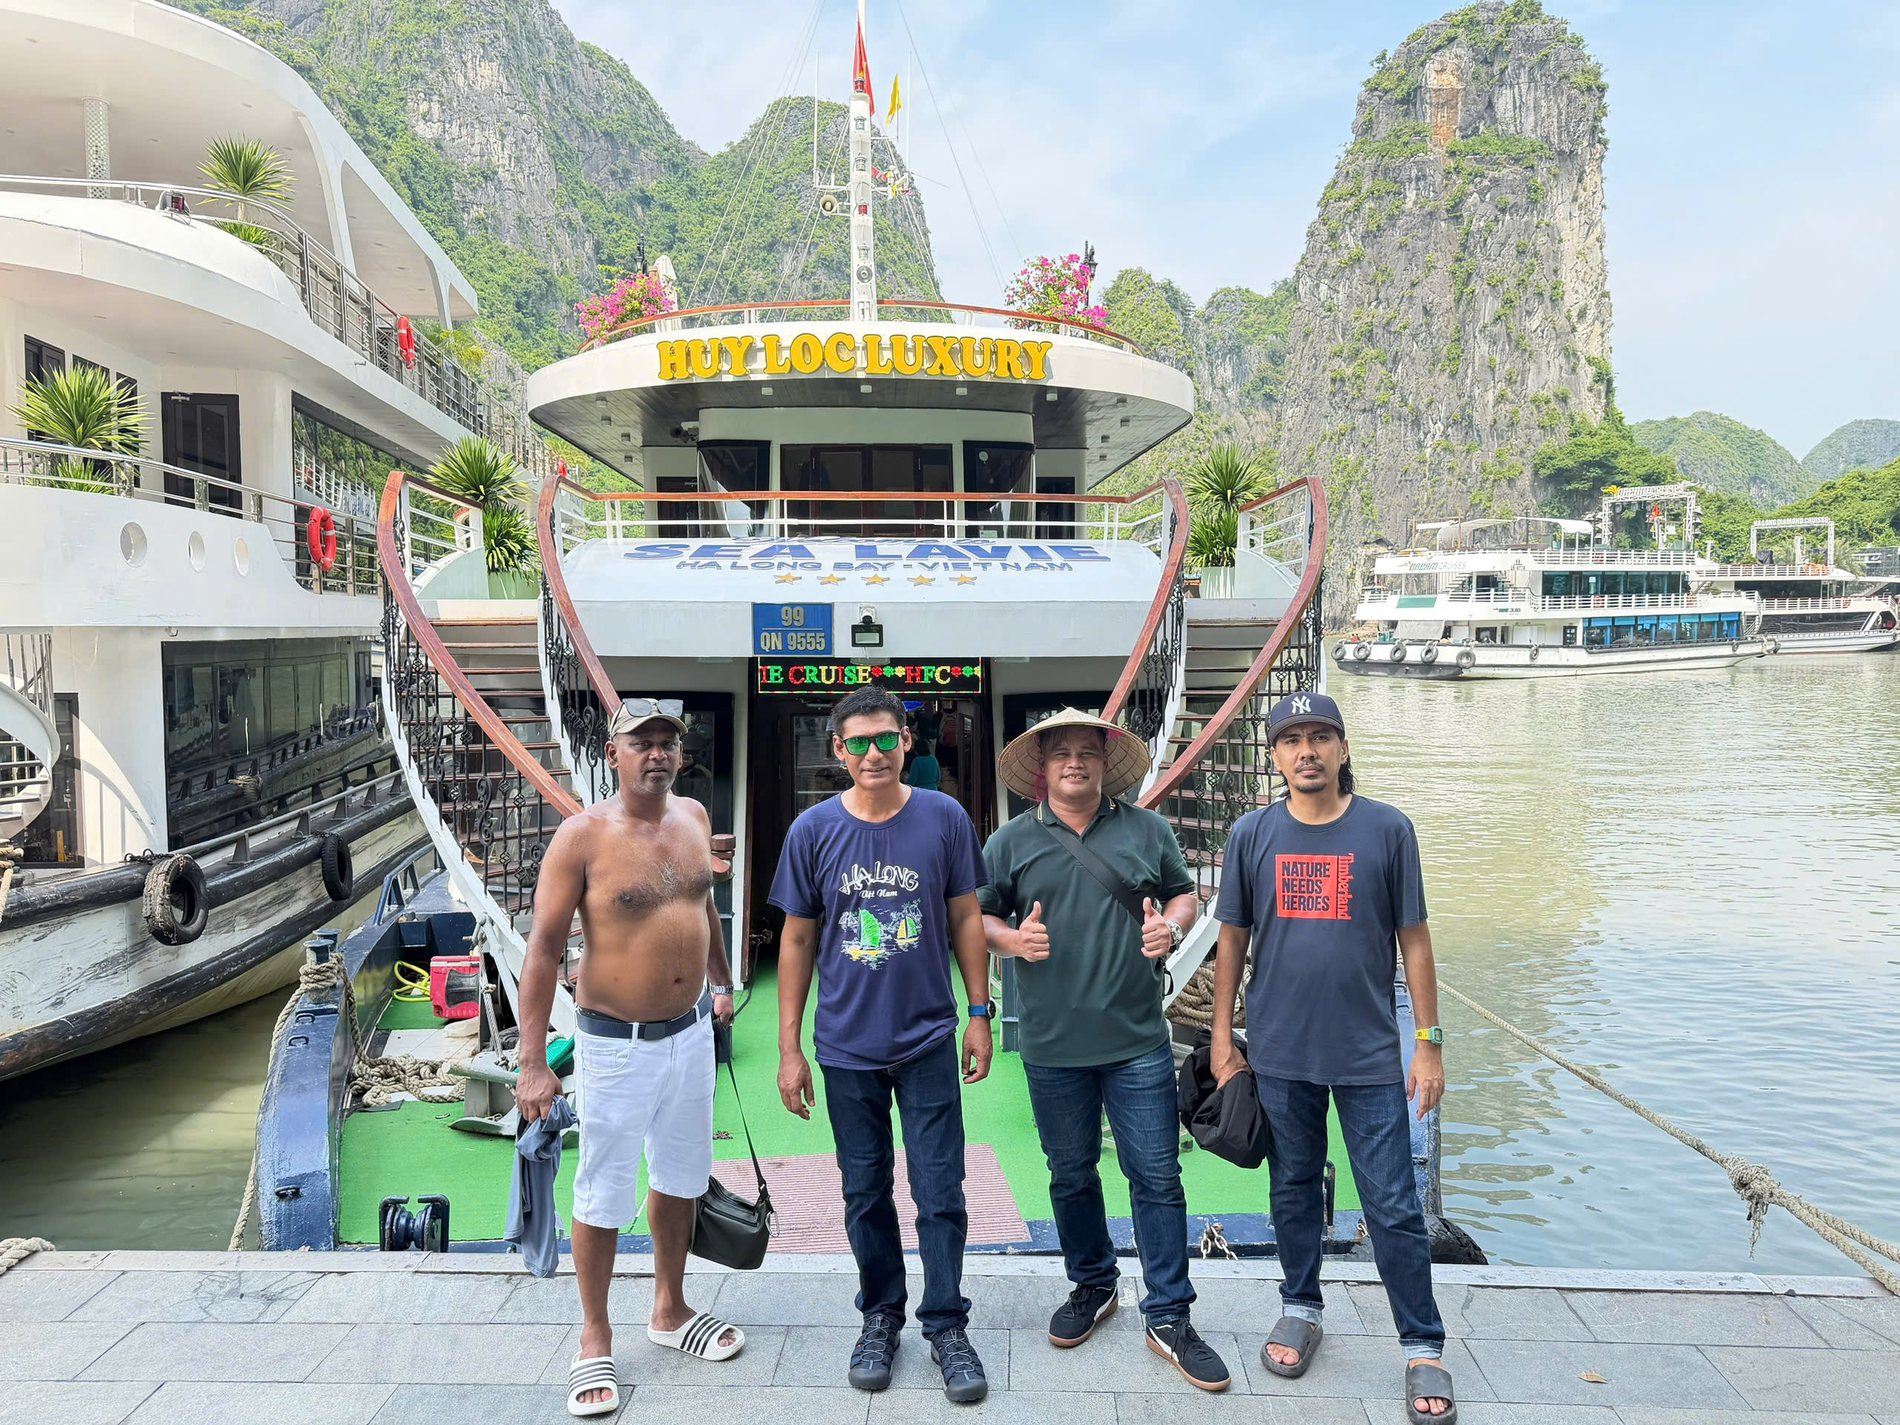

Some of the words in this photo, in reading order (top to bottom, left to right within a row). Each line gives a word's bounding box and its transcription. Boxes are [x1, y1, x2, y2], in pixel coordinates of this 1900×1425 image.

[657, 336, 755, 380] HUY
[761, 332, 856, 374] LOC
[862, 334, 1054, 380] LUXURY
[623, 543, 816, 560] SEA
[676, 561, 722, 571] HA
[730, 561, 822, 571] LONG
[833, 561, 895, 571] BAY
[781, 606, 805, 627] 99
[760, 632, 783, 652] QN
[787, 632, 826, 651] 9555
[788, 664, 873, 685] CRUISE
[904, 665, 951, 684] HFC
[1291, 695, 1312, 714] NY
[1282, 862, 1331, 878] NATURE
[1282, 878, 1323, 894] NEEDS
[1338, 852, 1355, 920] Timberland
[1282, 895, 1330, 911] HEROES
